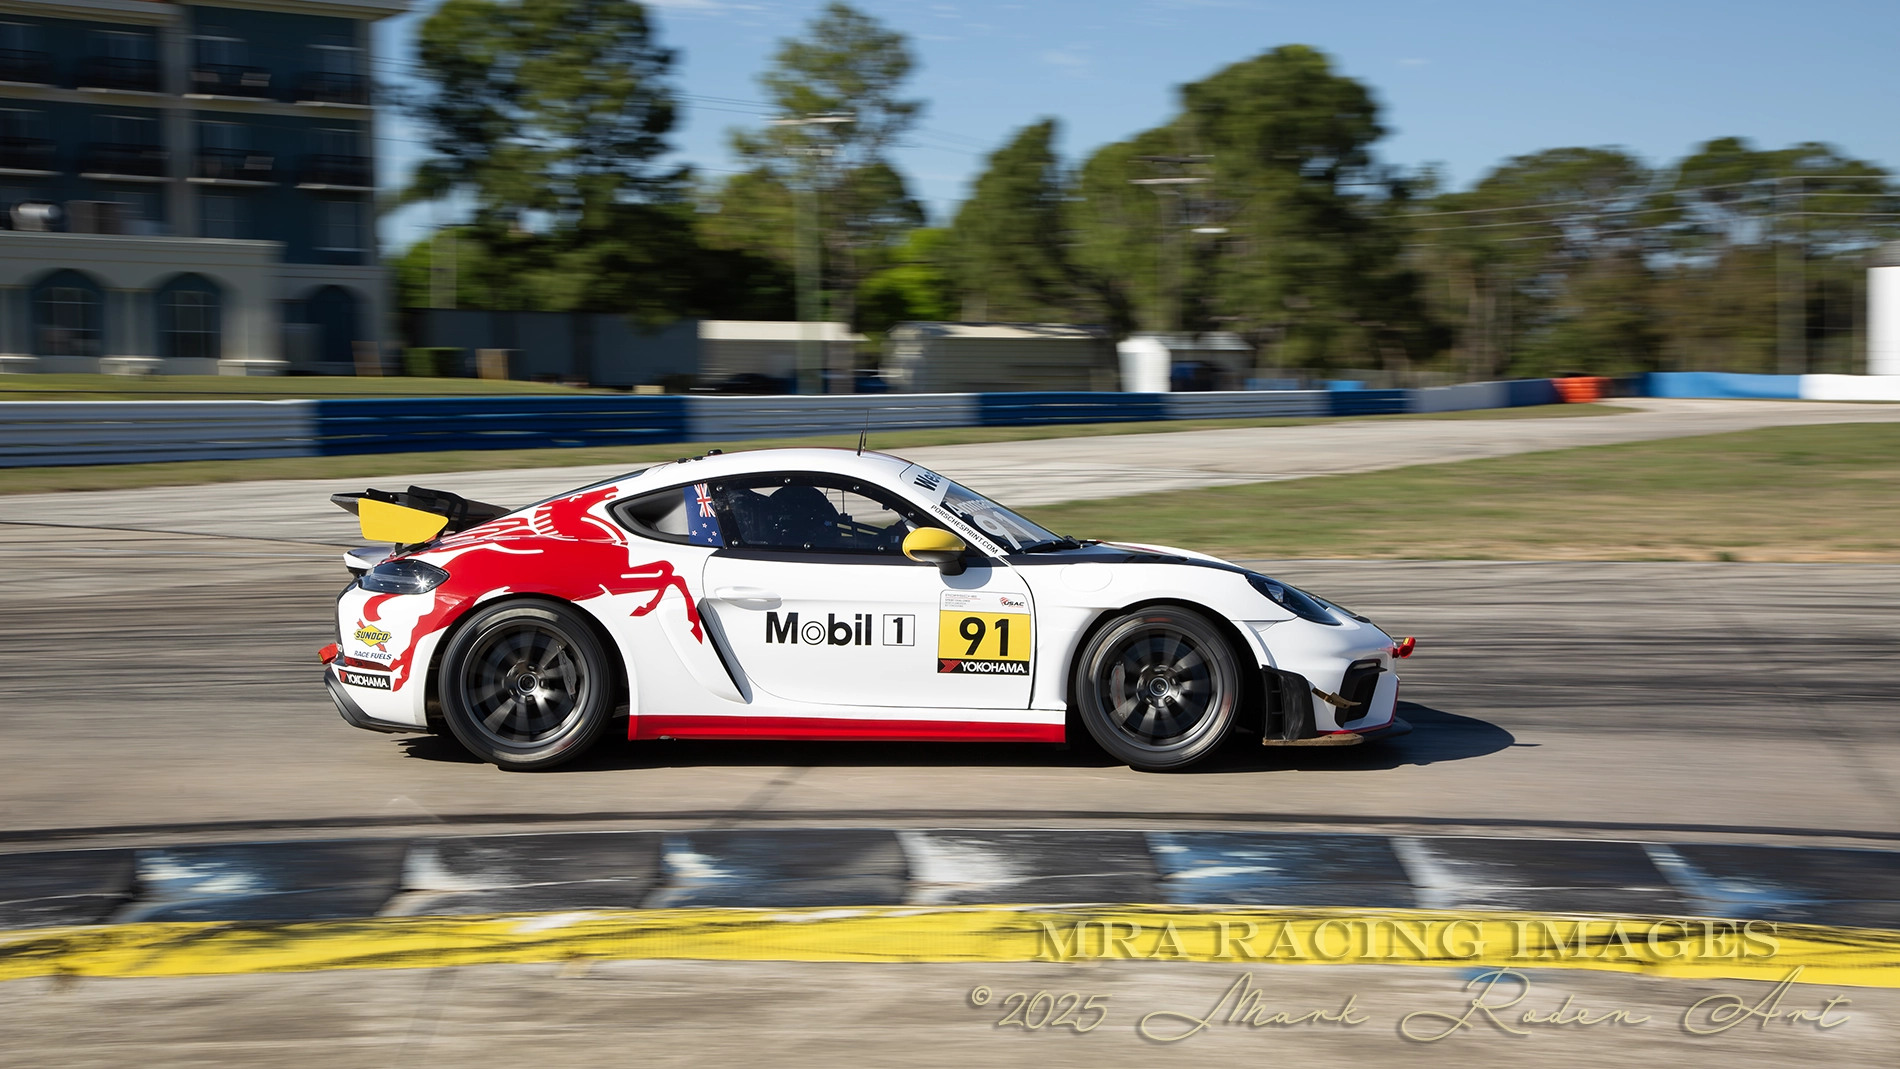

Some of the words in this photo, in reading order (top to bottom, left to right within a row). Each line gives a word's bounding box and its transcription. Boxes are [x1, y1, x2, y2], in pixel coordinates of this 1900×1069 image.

[930, 504, 999, 555] PORSCHESPRINT.COM
[355, 630, 390, 641] SUNOCO
[765, 611, 873, 646] Mobil
[892, 617, 903, 644] 1
[959, 616, 1009, 657] 91
[353, 650, 369, 659] RACE
[370, 651, 393, 661] FUELS
[961, 661, 1025, 674] YOKOHAMA
[346, 673, 389, 688] YOKOHAMA
